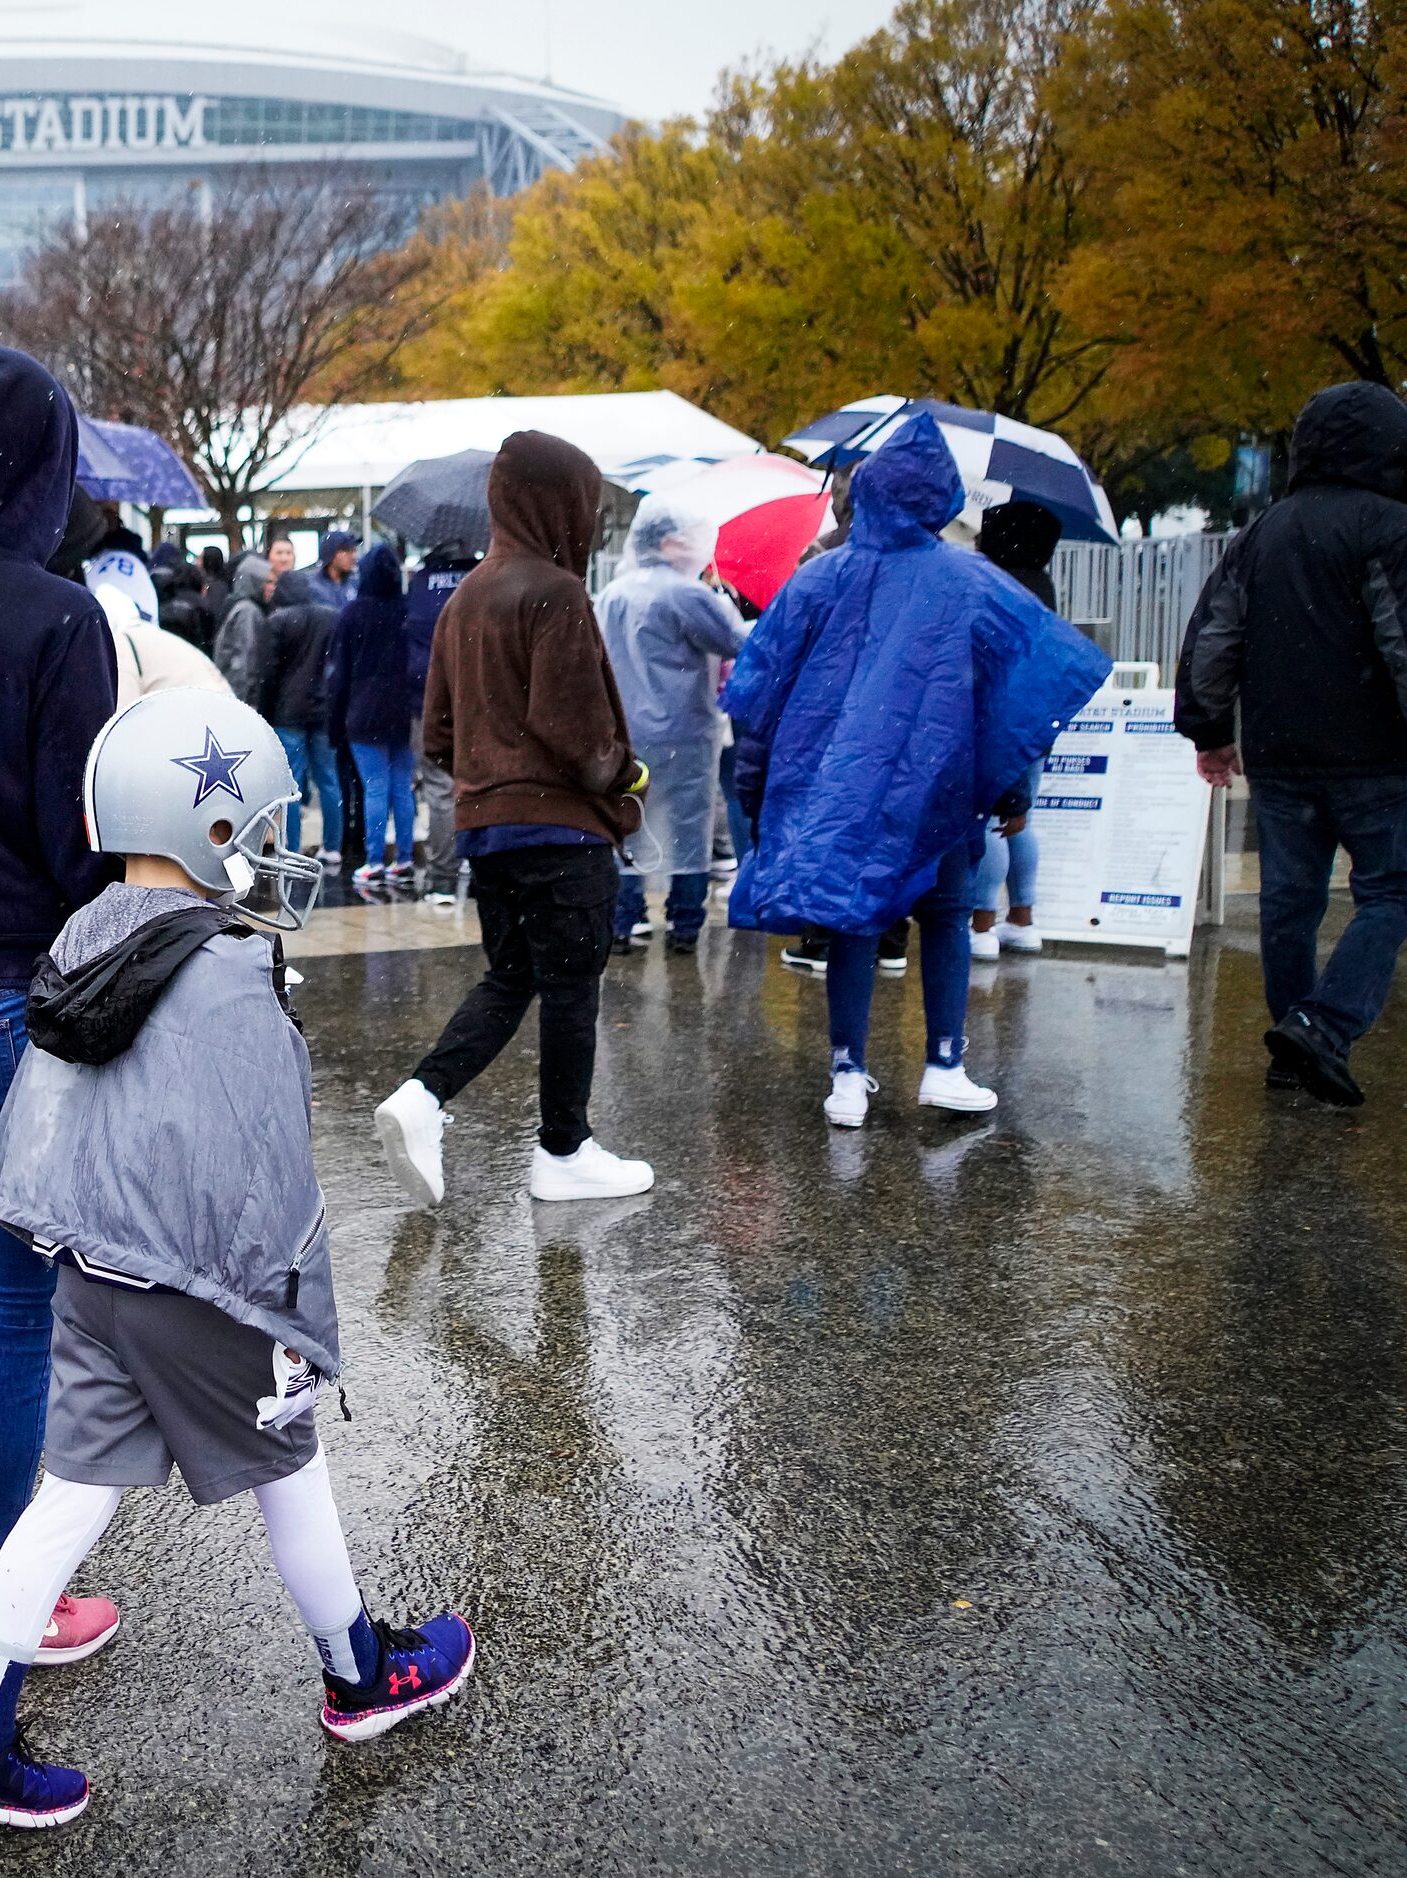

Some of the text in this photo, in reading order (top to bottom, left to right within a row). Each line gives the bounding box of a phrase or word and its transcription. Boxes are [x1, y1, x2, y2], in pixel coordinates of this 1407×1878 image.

[1111, 707, 1166, 718] STADIUM
[1080, 722, 1111, 731] SEARCH
[1062, 798, 1098, 808] CONDUCT
[1109, 893, 1172, 906] REPORT ISSUES
